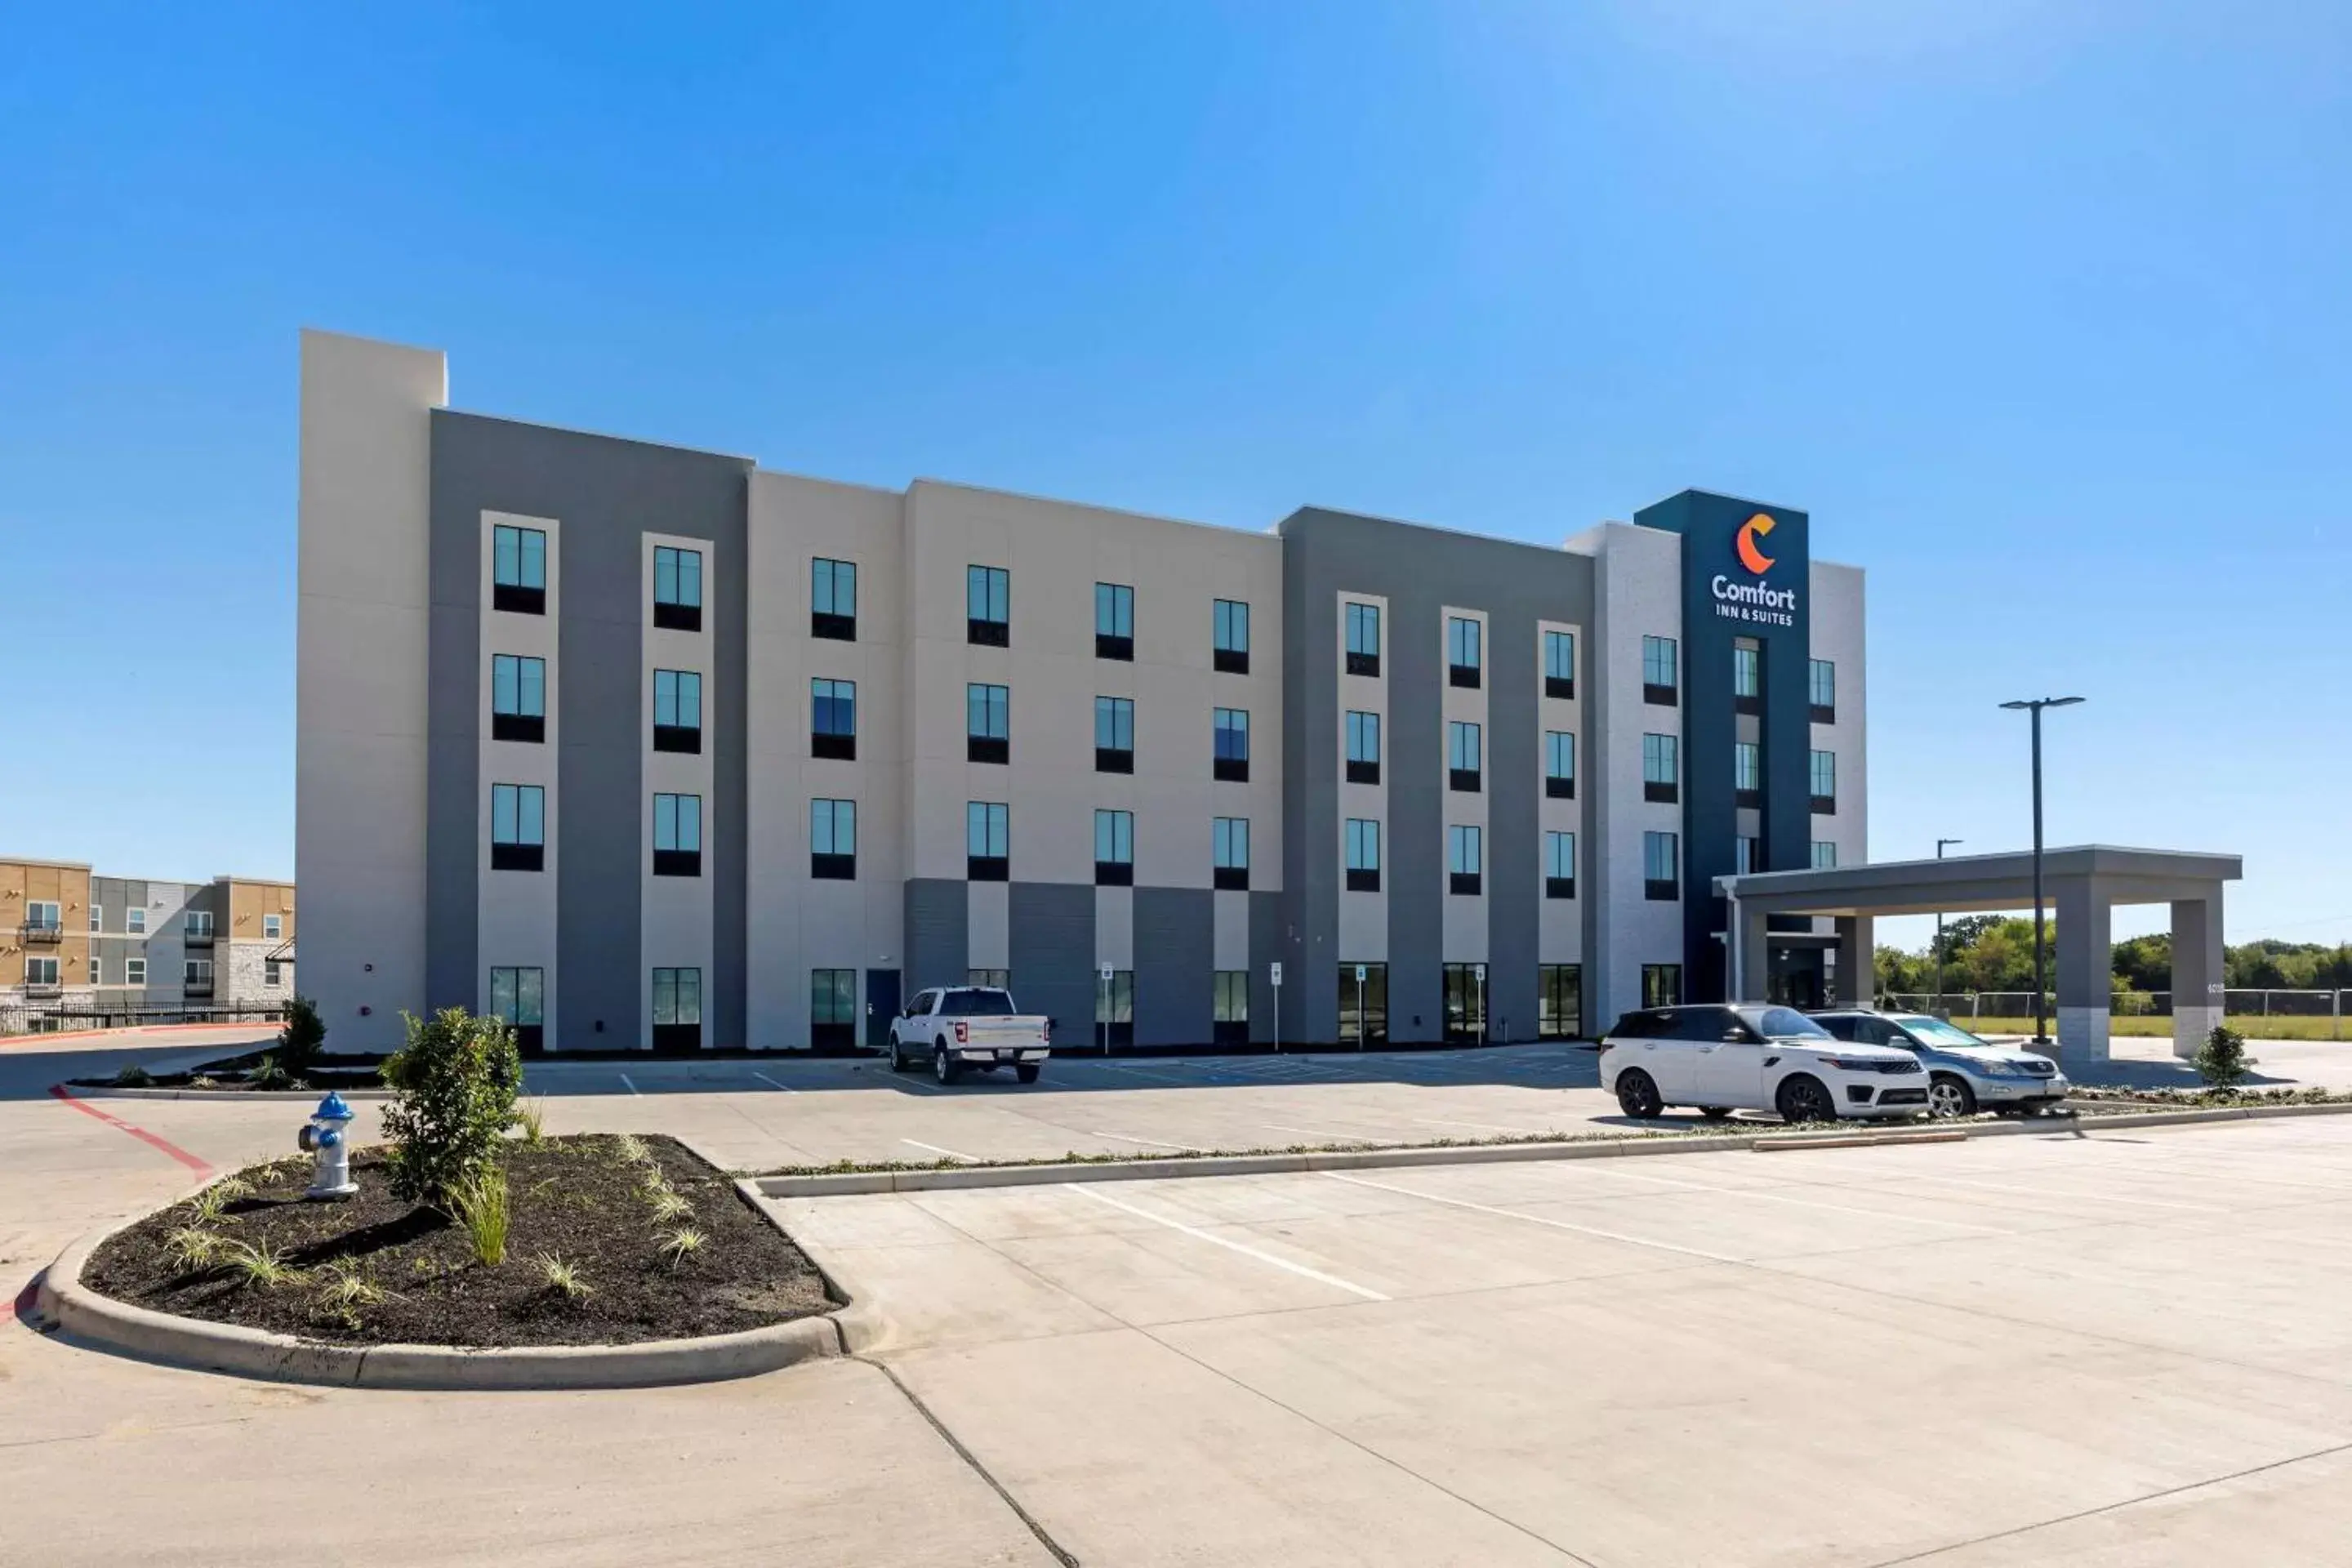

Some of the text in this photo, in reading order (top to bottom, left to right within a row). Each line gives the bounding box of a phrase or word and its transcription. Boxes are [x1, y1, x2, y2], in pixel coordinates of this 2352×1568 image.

[1712, 575, 1795, 610] Comfort
[1716, 604, 1793, 626] INN & SUITES
